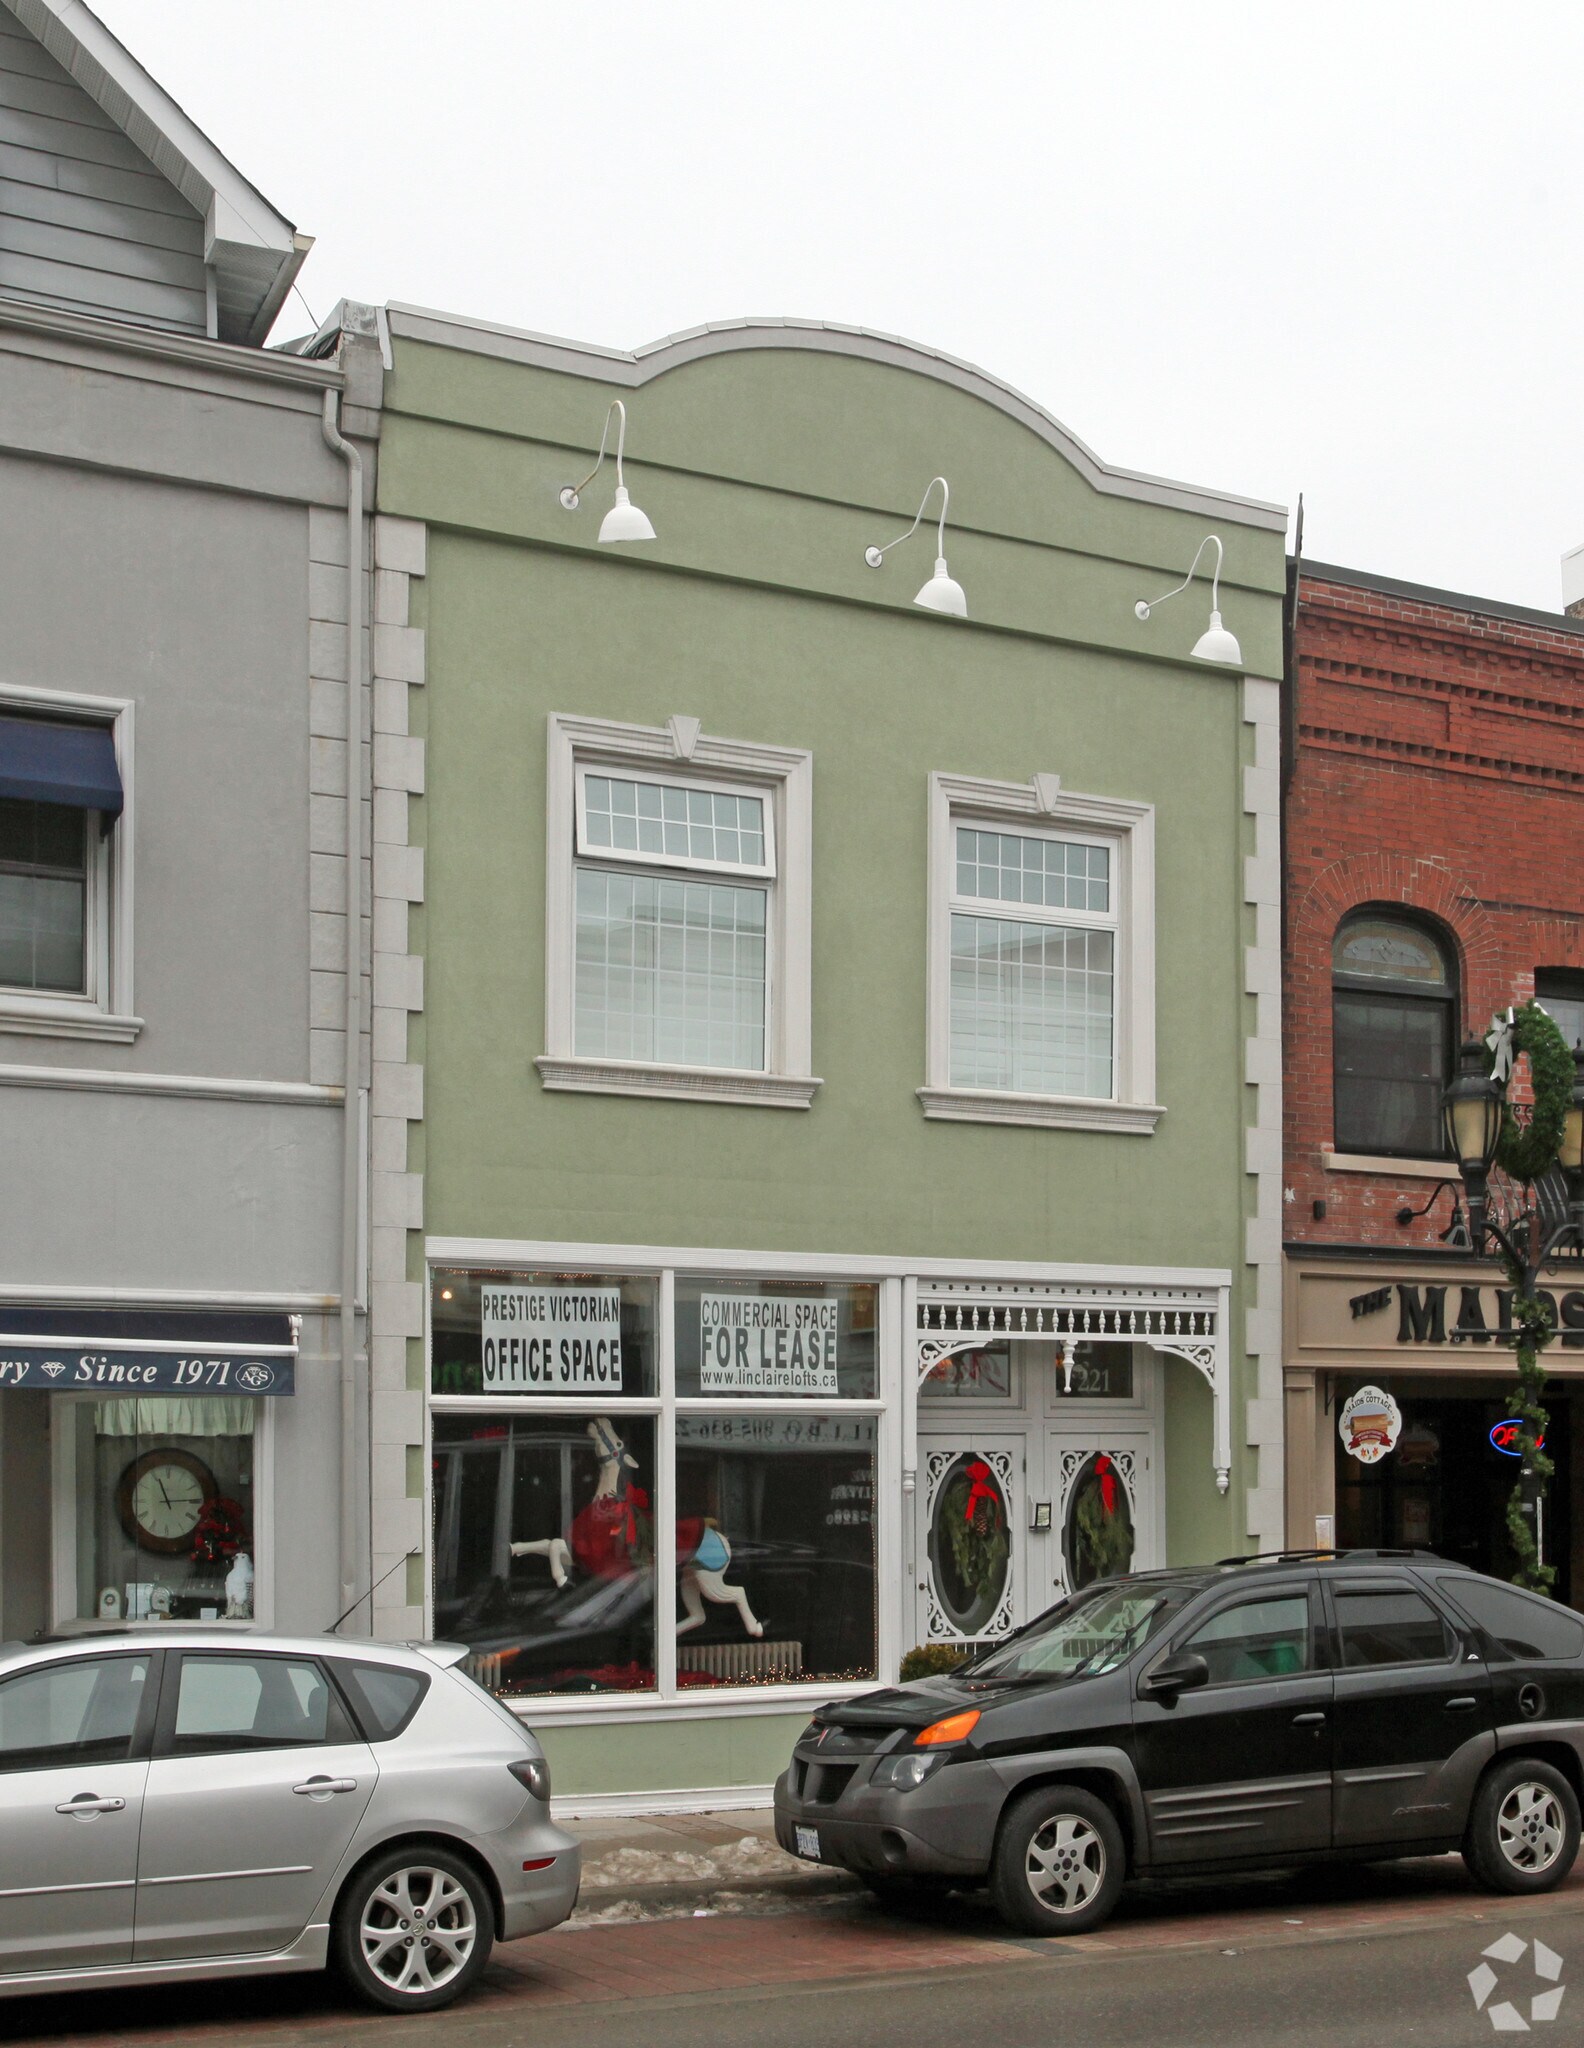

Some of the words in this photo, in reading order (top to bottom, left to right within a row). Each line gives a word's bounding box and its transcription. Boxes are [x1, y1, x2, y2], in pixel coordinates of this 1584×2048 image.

[483, 1294, 546, 1322] PRESTIGE
[550, 1296, 619, 1322] VICTORIAN
[702, 1300, 790, 1329] COMMERCIAL
[795, 1304, 836, 1330] SPACE
[1350, 1286, 1392, 1319] THE
[484, 1337, 553, 1382] OFFICE
[560, 1338, 620, 1382] SPACE
[701, 1326, 750, 1368] FOR
[760, 1328, 836, 1371] LEASE
[74, 1355, 158, 1384] Since
[172, 1359, 231, 1386] 1971
[702, 1369, 837, 1388] www.linclairelofts.ca
[1077, 1368, 1112, 1392] 221
